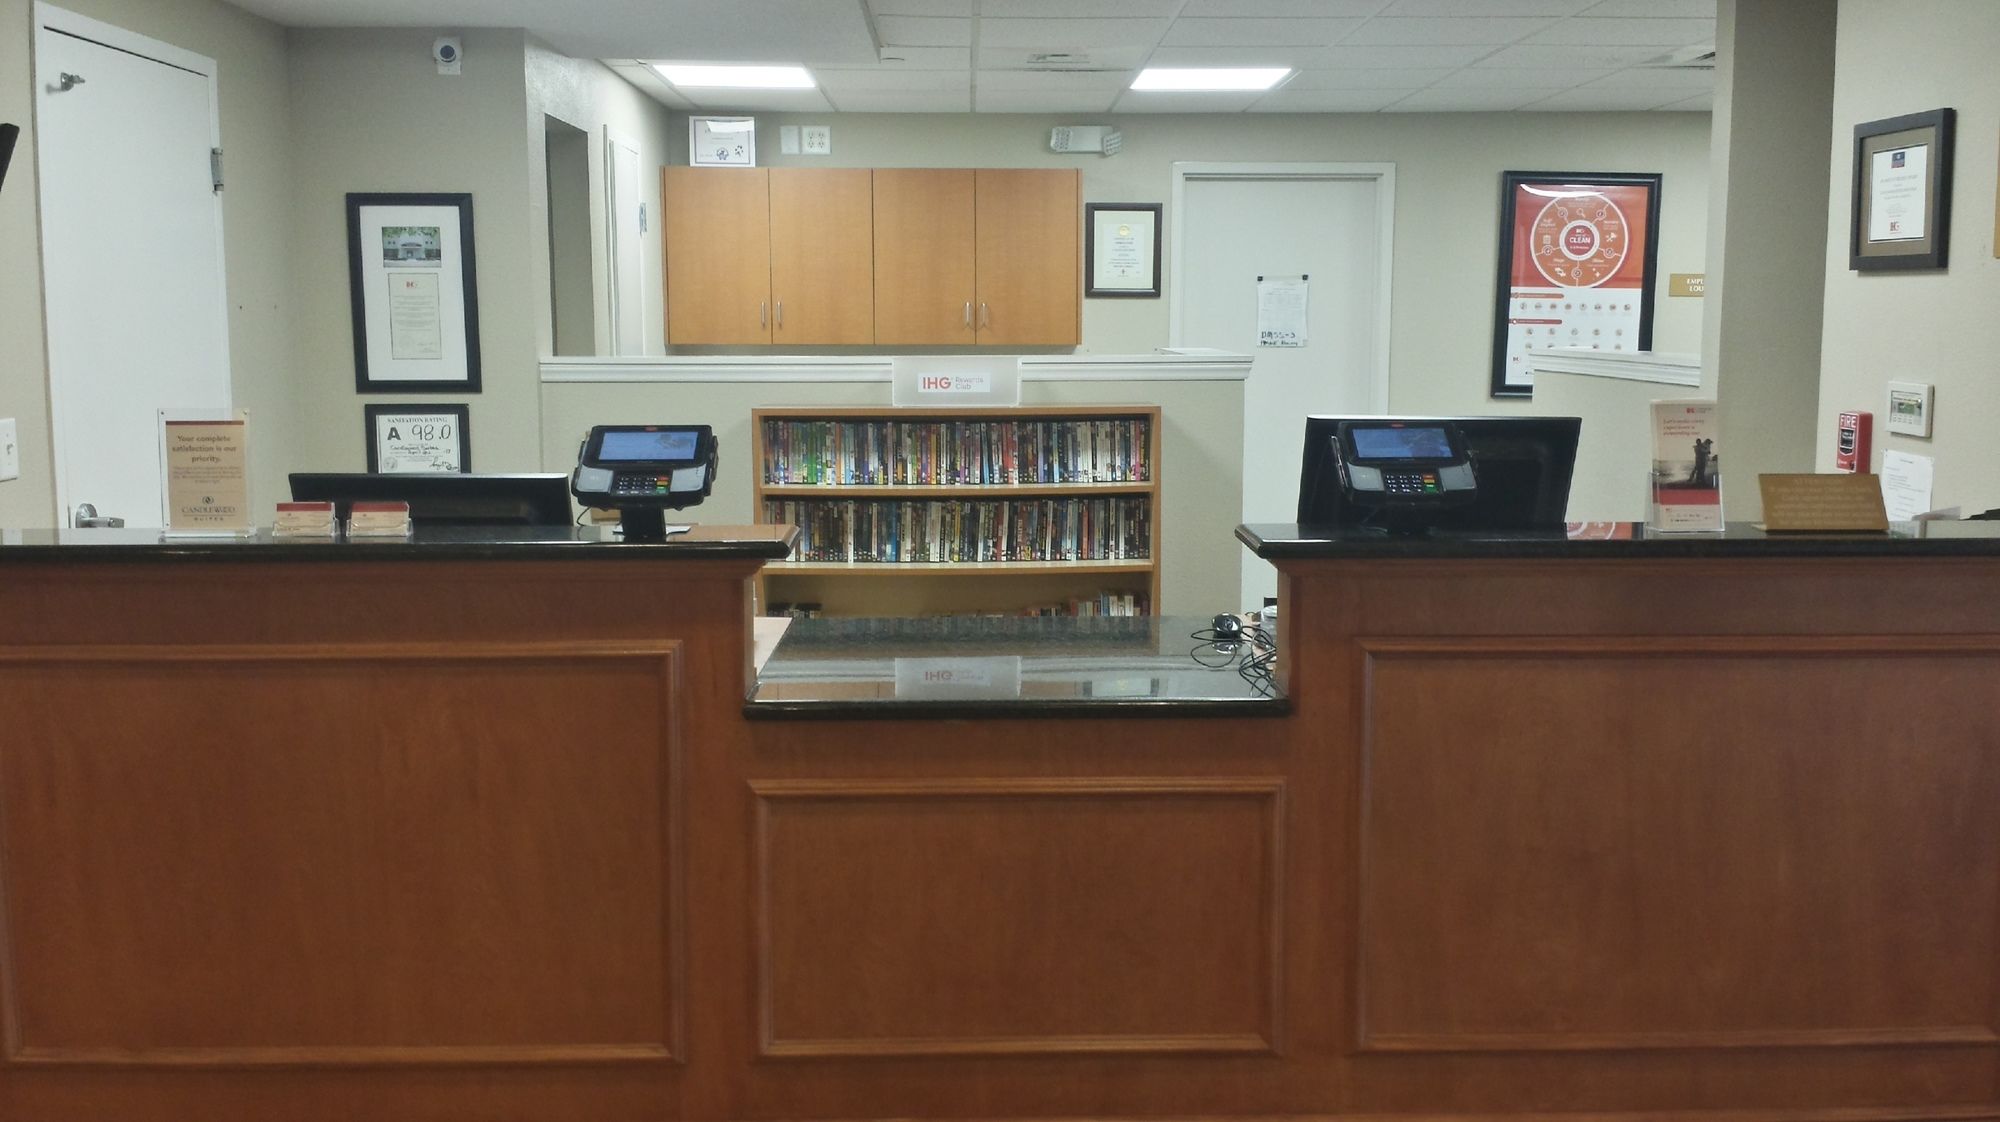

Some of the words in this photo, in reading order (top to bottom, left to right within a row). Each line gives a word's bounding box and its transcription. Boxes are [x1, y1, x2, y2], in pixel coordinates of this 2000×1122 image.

[923, 377, 951, 389] IHG
[1840, 415, 1856, 428] FIRE
[388, 427, 401, 440] A
[412, 425, 451, 440] 98.0
